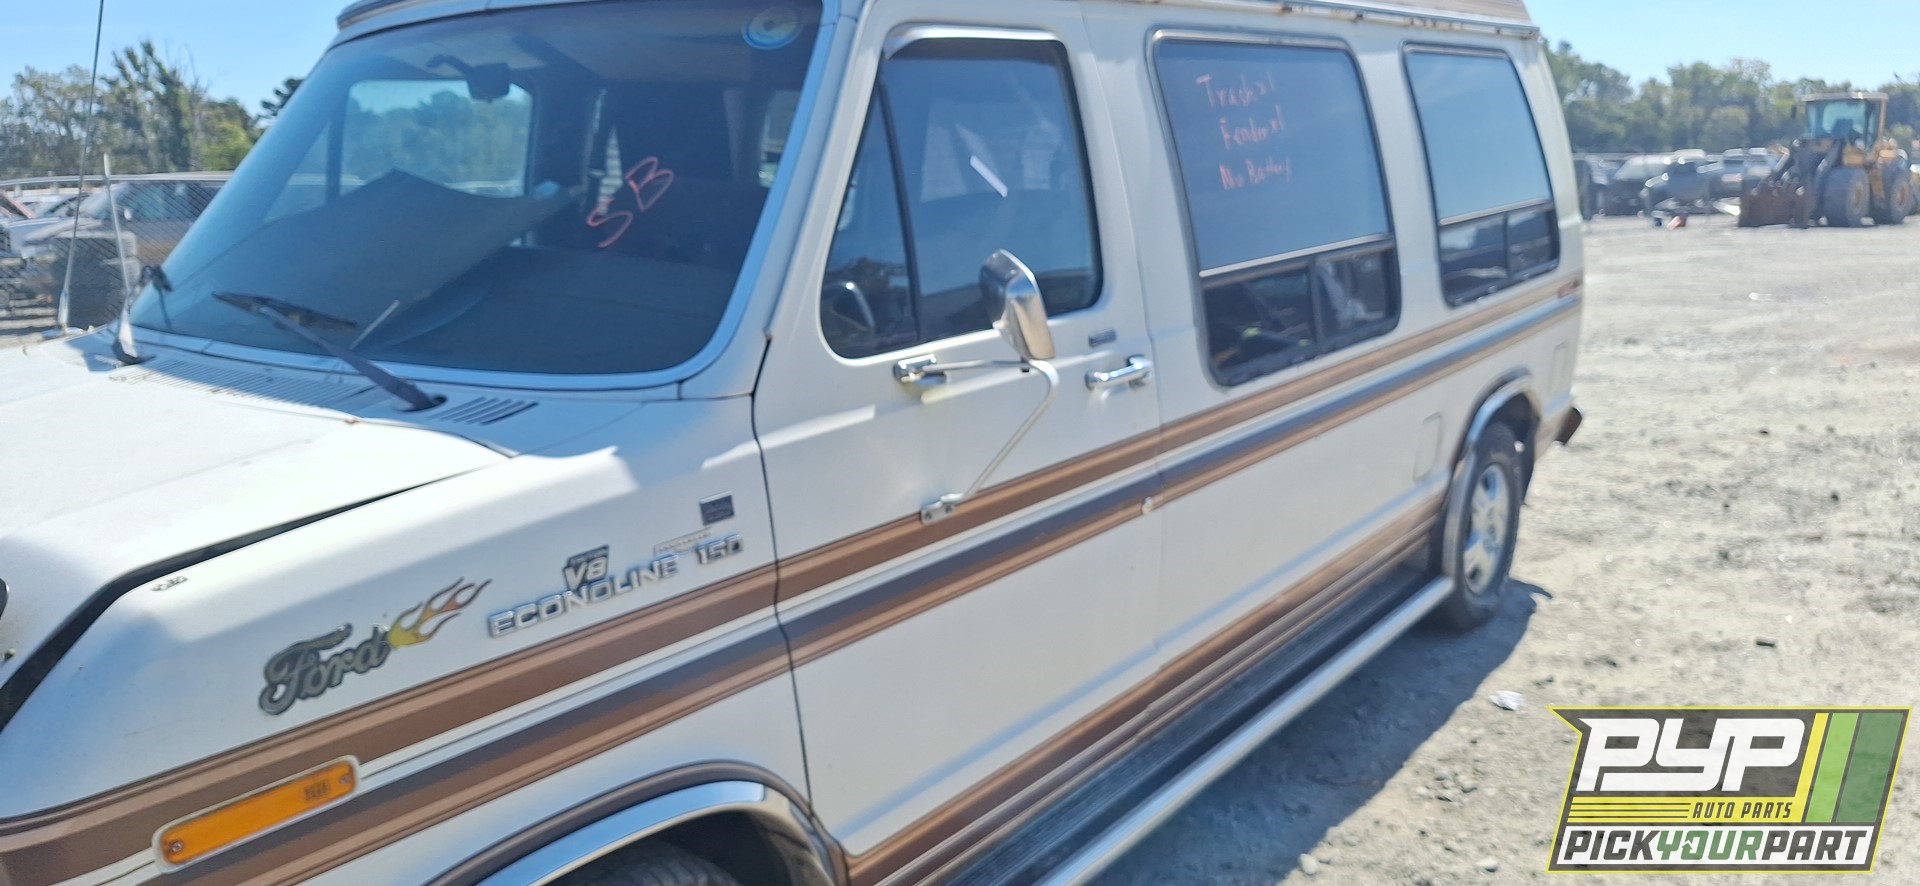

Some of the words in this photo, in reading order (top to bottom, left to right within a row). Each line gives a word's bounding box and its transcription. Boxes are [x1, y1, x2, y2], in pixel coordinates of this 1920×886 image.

[586, 156, 674, 248] SB
[1219, 164, 1245, 191] No
[488, 553, 679, 638] ECONOLINE
[694, 532, 745, 565] 150
[564, 554, 609, 592] V8
[258, 622, 392, 716] Ford
